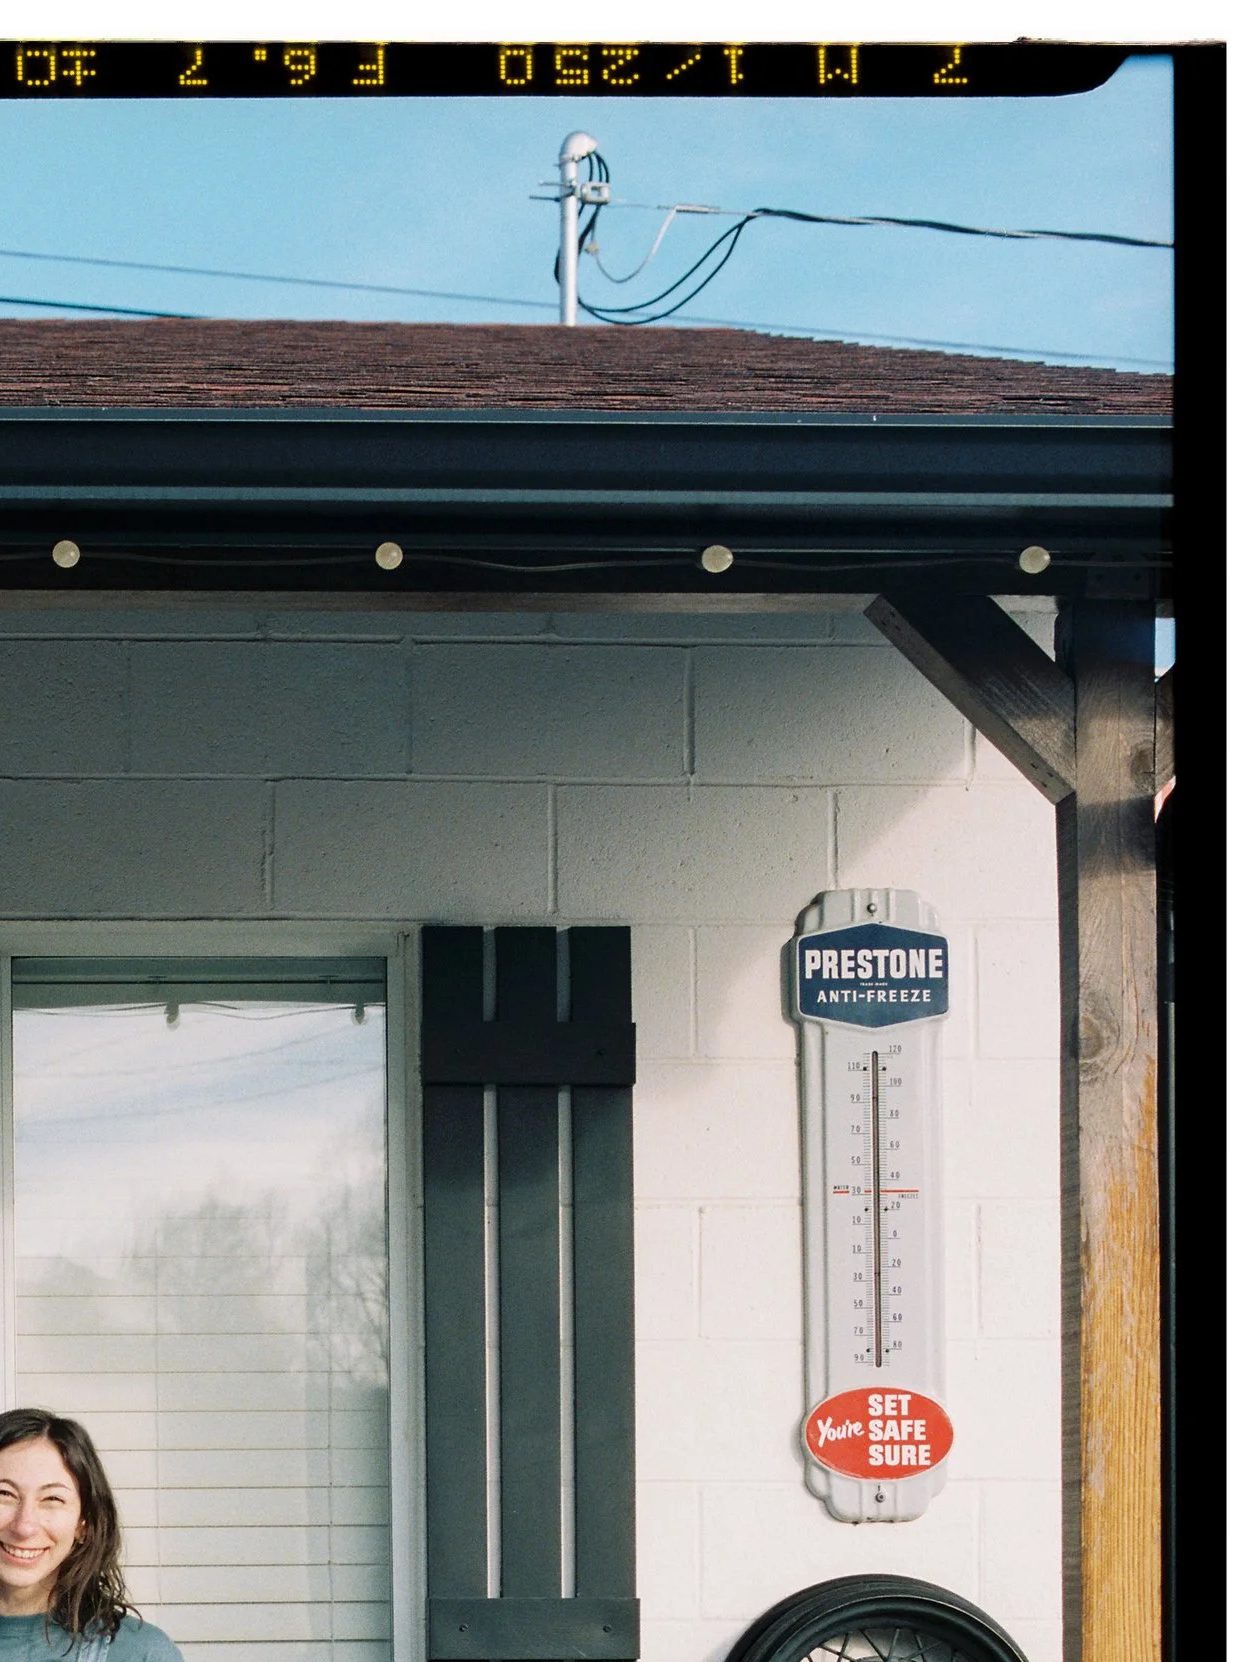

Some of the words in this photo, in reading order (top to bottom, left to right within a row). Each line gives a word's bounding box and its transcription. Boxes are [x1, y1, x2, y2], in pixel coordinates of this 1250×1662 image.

[805, 948, 943, 979] PRESTONE
[817, 989, 932, 1003] ANTI-FREEZE
[868, 1394, 911, 1416] SET
[817, 1417, 864, 1448] You're
[868, 1419, 926, 1441] SAFE
[868, 1444, 931, 1466] SURE
